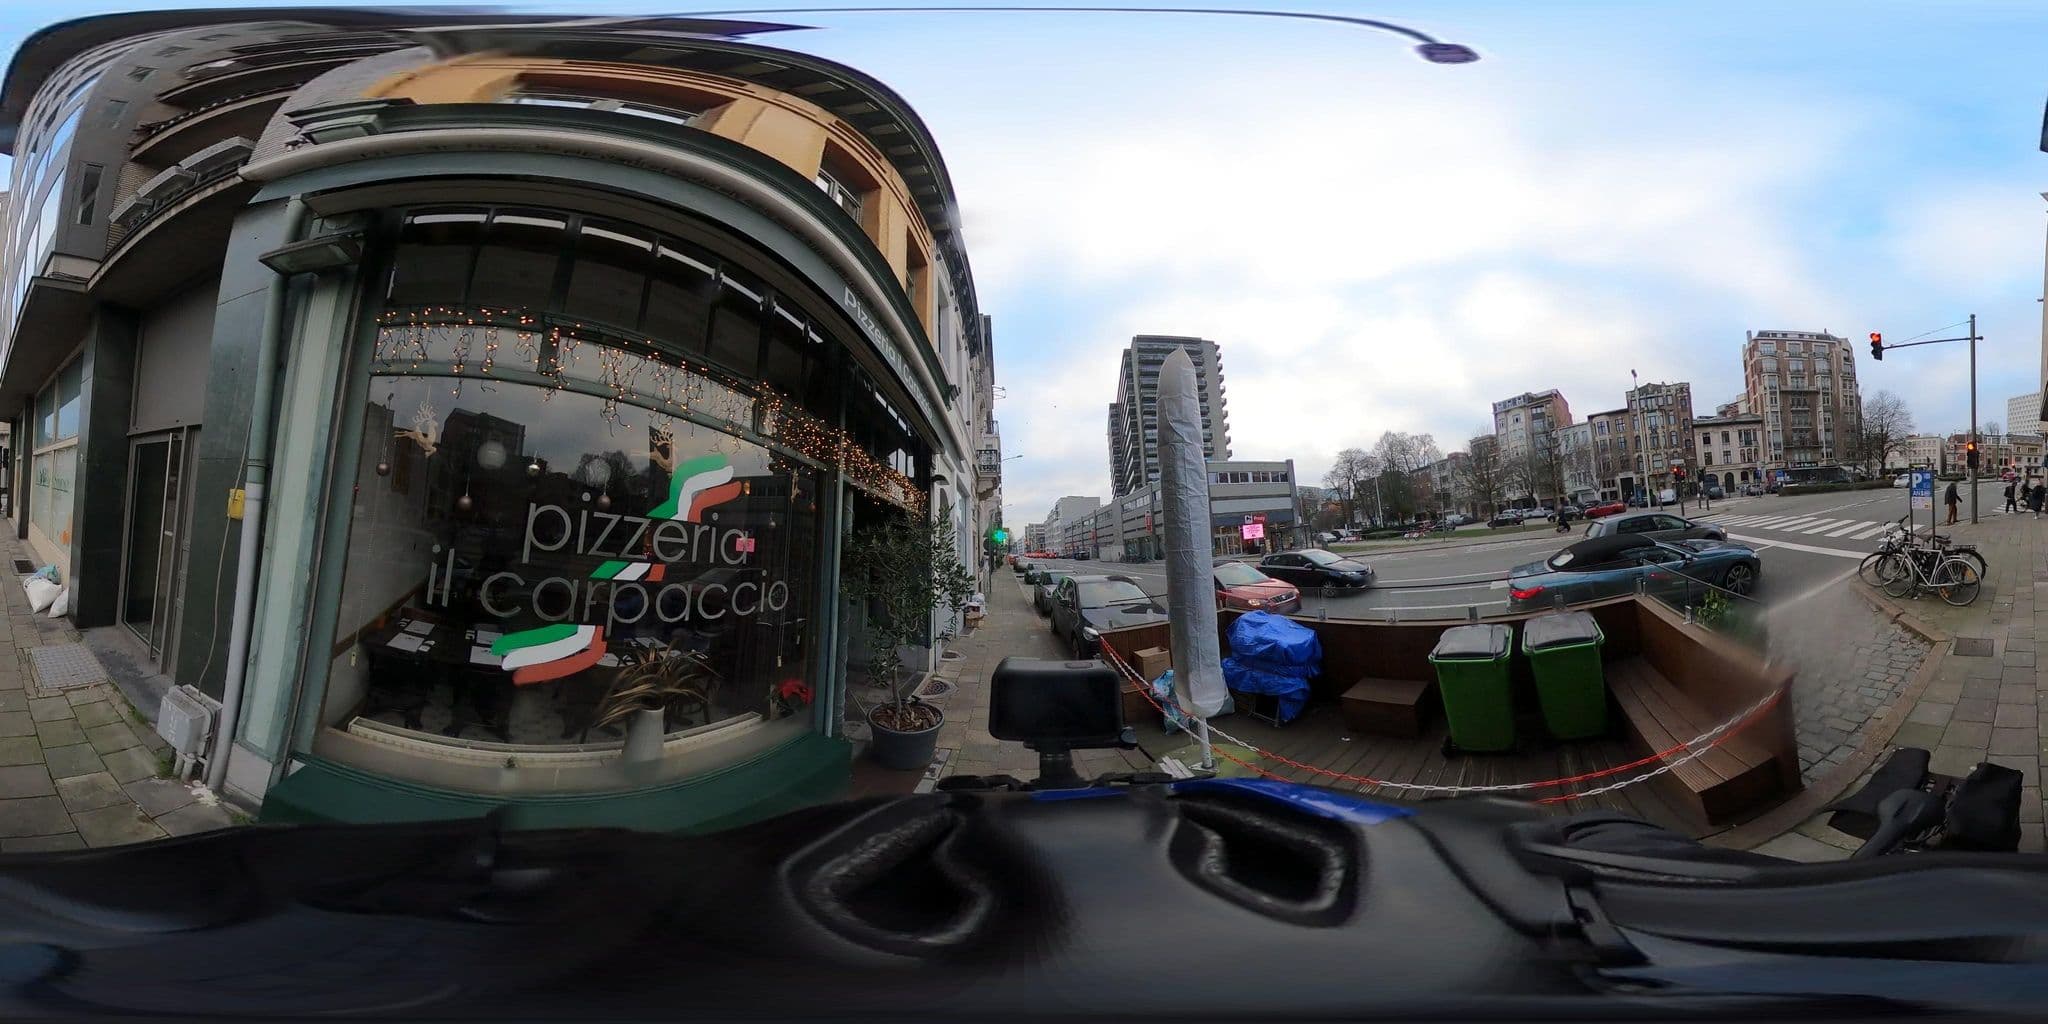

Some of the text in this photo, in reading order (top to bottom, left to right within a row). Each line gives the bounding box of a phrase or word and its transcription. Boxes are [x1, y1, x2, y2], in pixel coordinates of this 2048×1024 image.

[844, 286, 896, 363] Pizzeria
[1911, 472, 1923, 489] P
[521, 491, 750, 566] pizzeria
[426, 543, 789, 639] il carpaccio
